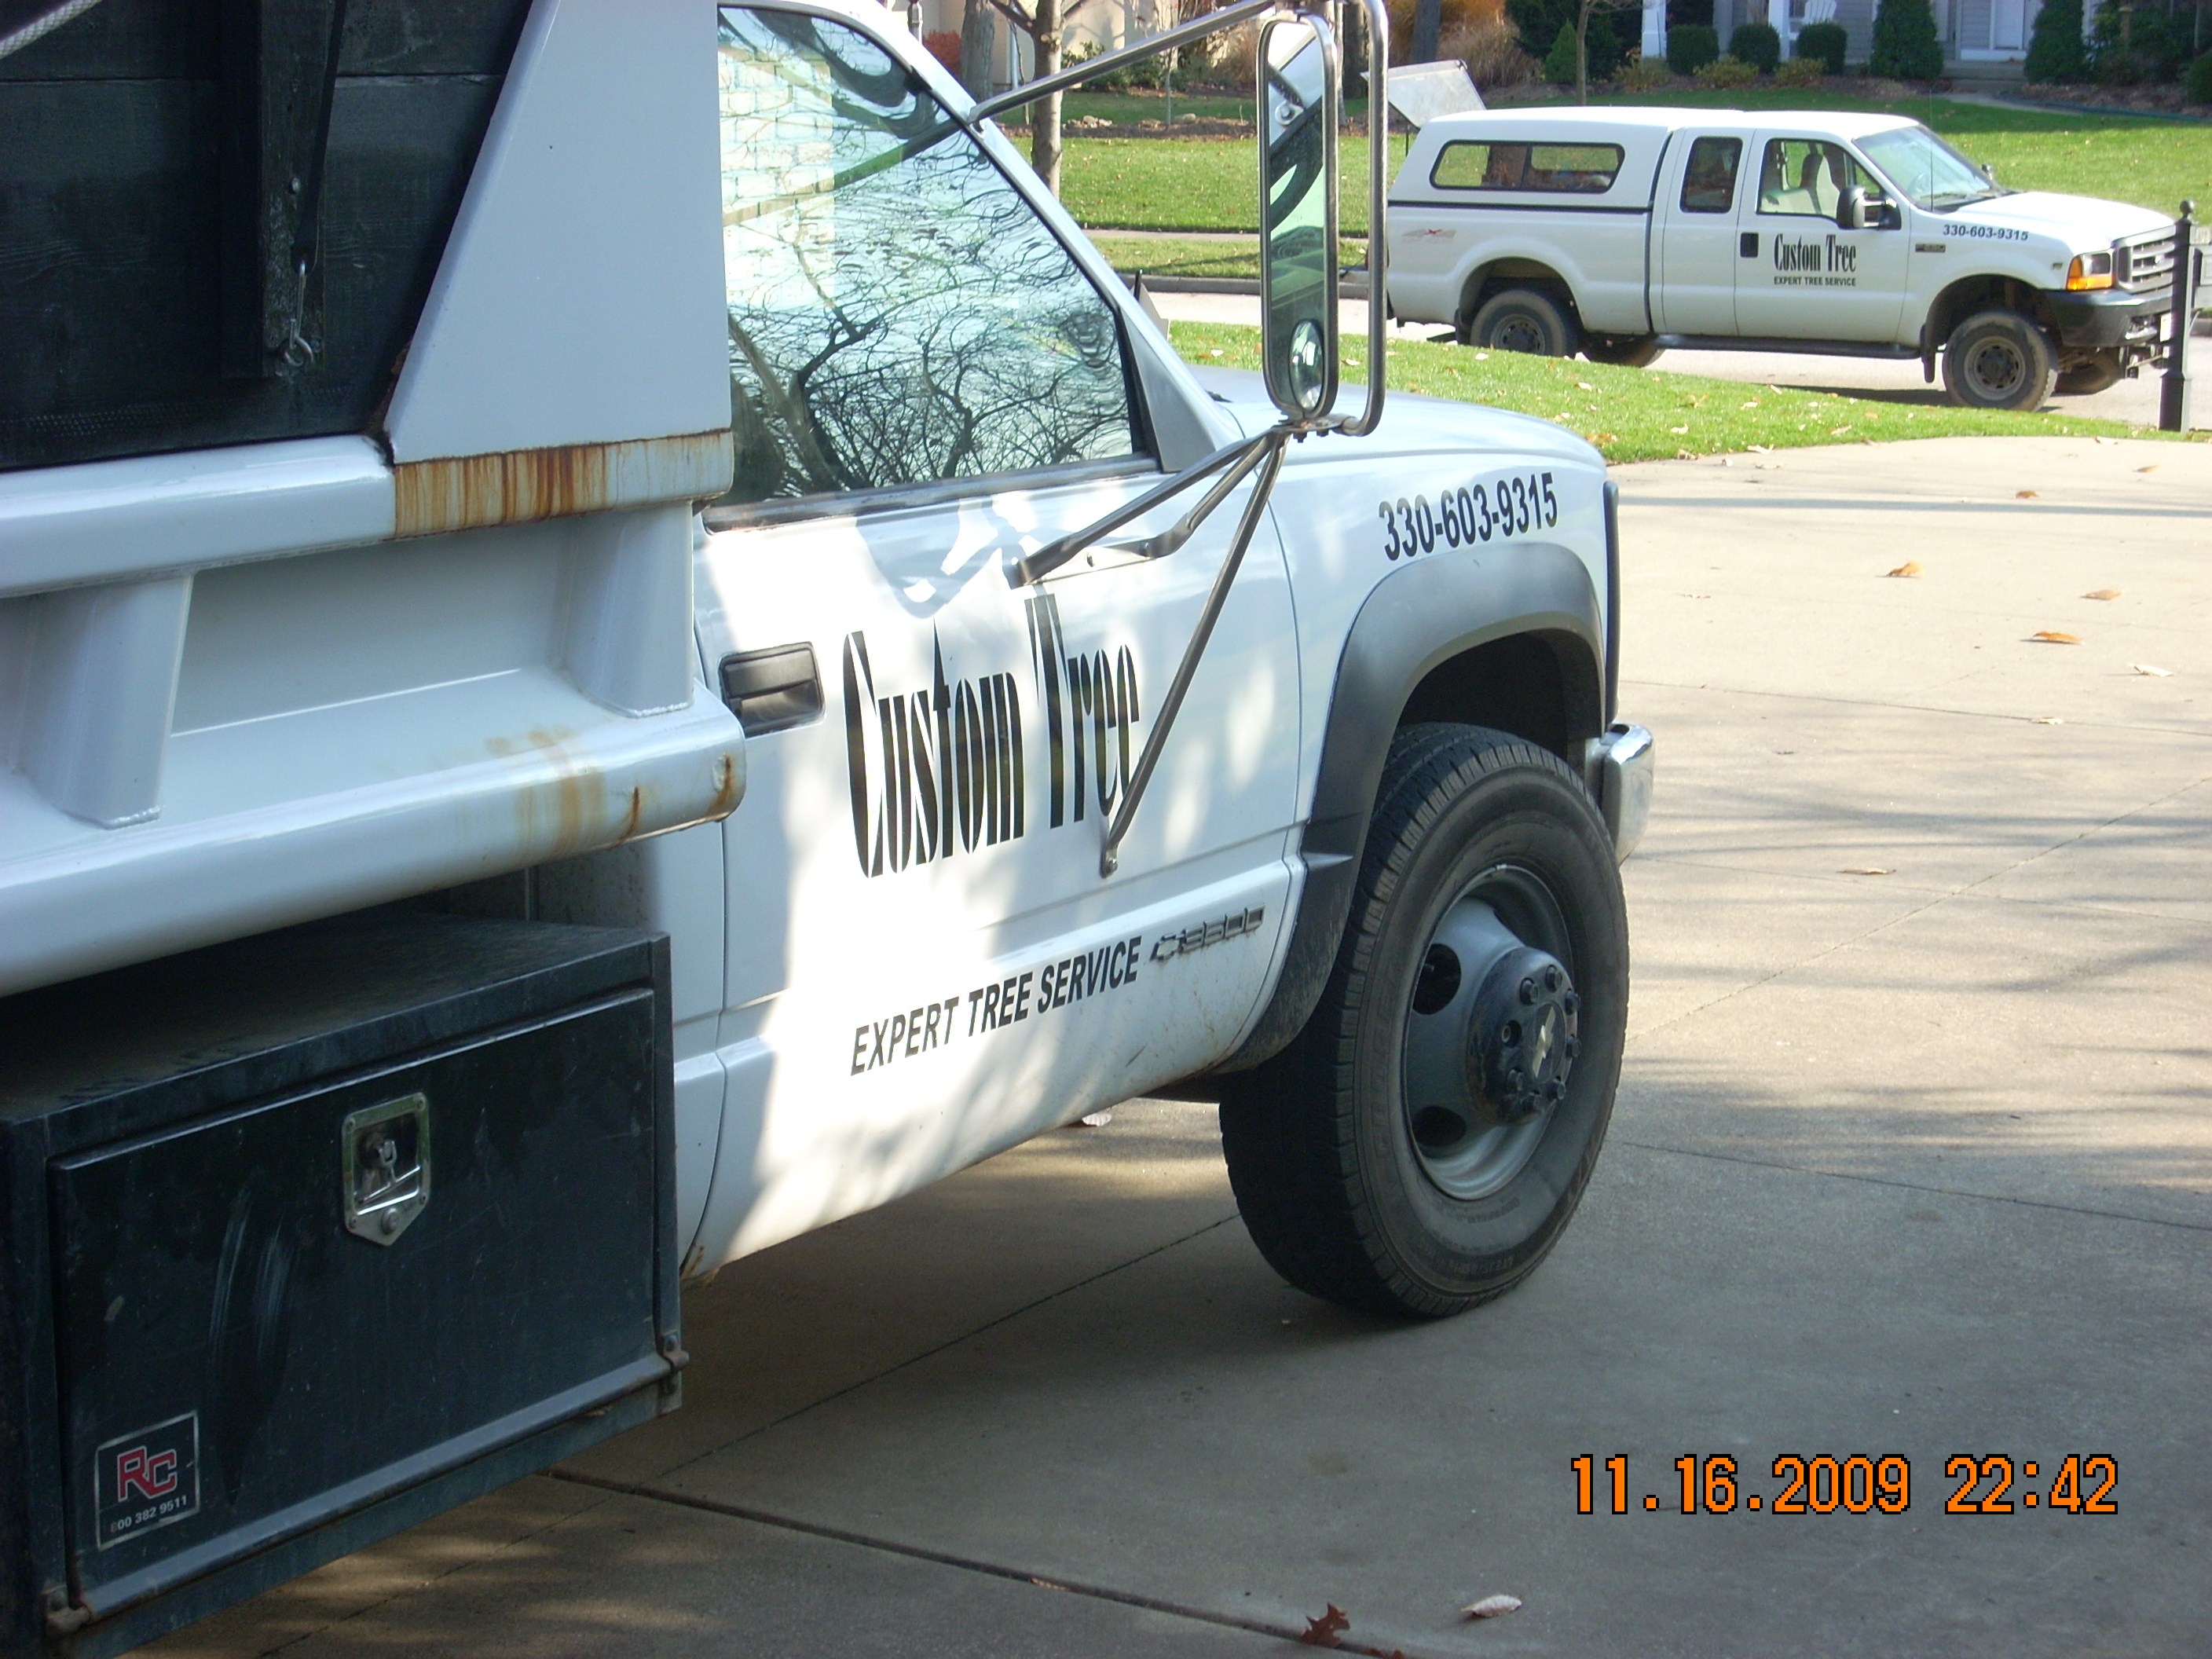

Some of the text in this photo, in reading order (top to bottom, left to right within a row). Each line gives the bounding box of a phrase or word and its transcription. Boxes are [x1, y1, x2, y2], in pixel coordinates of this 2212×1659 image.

[1774, 233, 1856, 272] Custom Tree
[1943, 224, 2029, 241] 330-603-9315
[1774, 276, 1855, 286] EXPERT TREE SERVICE
[1379, 472, 1558, 561] 330-603-9315
[843, 593, 1140, 878] Custom Tree
[851, 936, 1141, 1075] EXPERT TREE SERVICE
[117, 1445, 178, 1503] RC
[134, 1507, 156, 1524] 382
[159, 1495, 187, 1514] 9511
